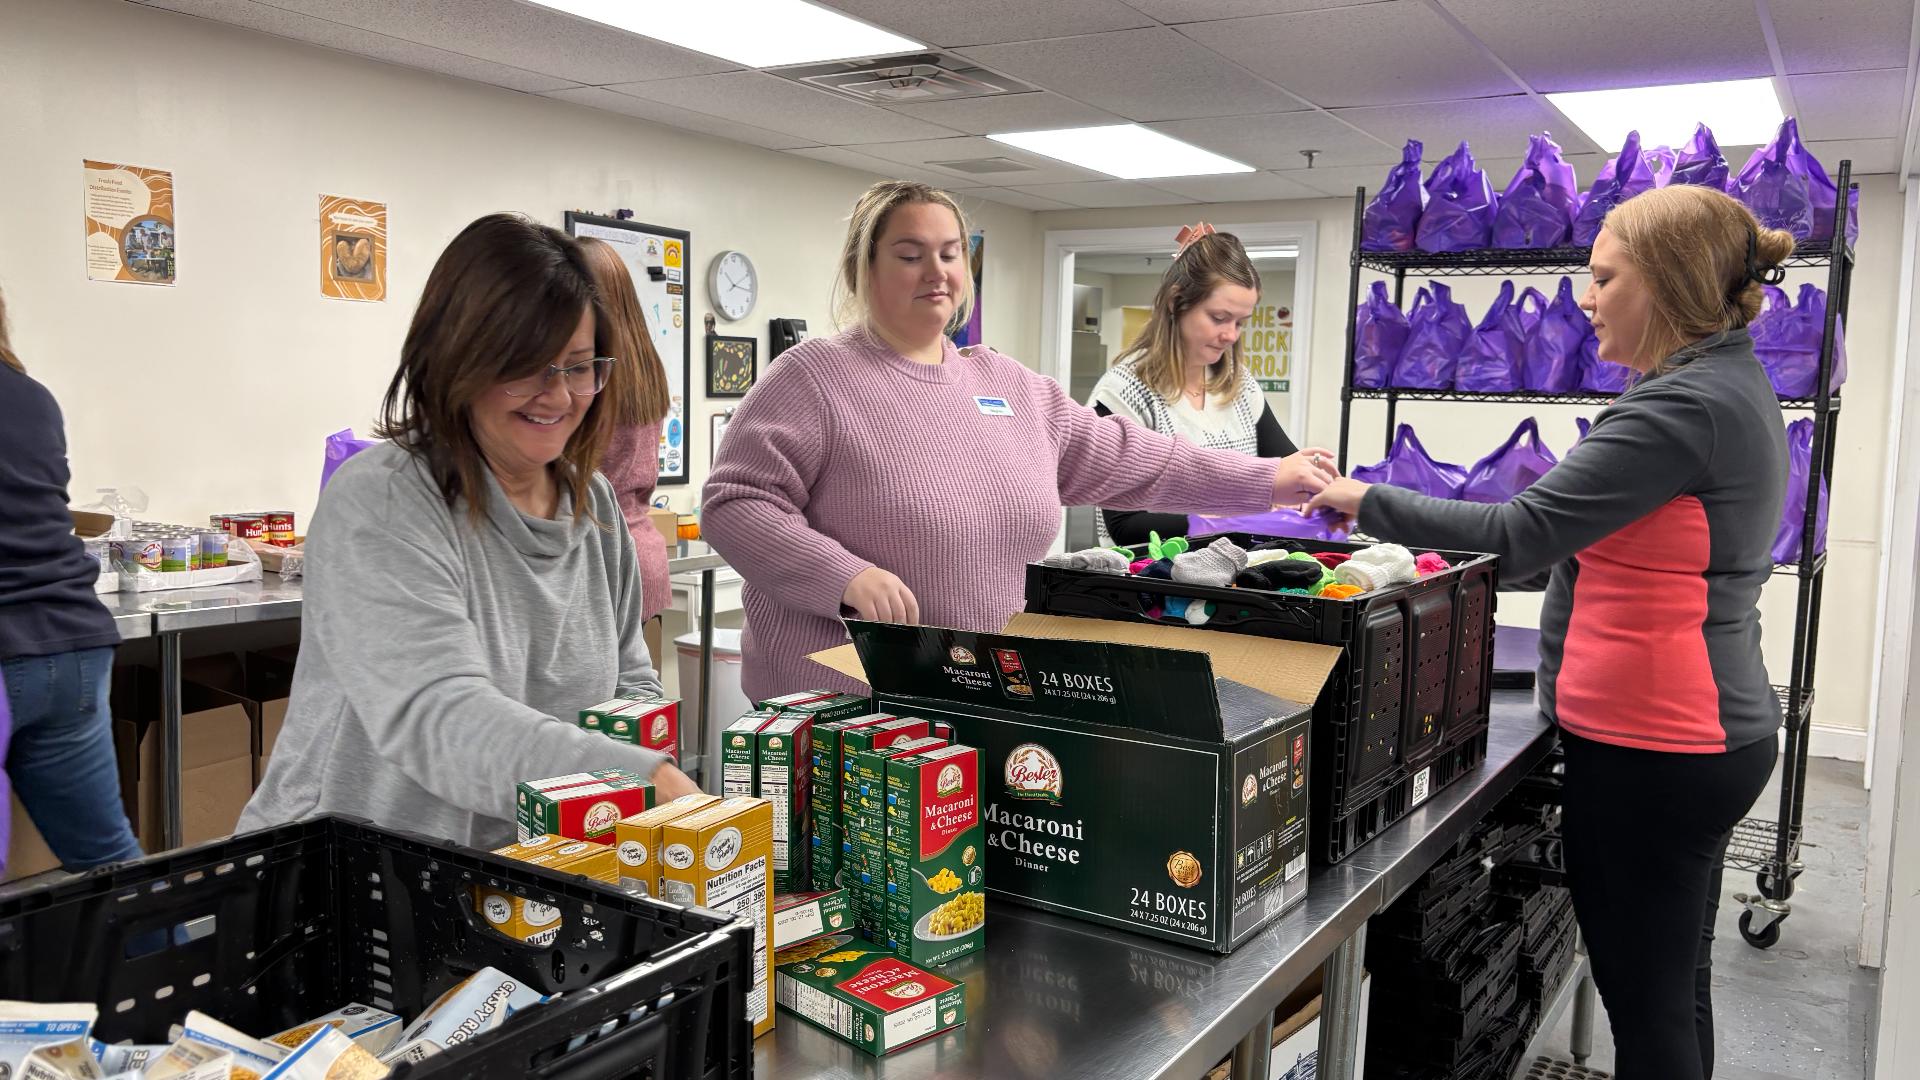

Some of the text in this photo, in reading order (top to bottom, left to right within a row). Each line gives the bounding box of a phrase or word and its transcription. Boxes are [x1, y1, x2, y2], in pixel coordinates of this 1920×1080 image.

[1243, 305, 1276, 328] HE
[1241, 330, 1293, 352] LOCK
[1243, 354, 1288, 377] PROJ
[942, 666, 991, 680] Macaroni
[1038, 671, 1113, 692] 24 BOXES
[1259, 756, 1288, 780] Macaroni
[925, 794, 974, 818] Macaroni
[984, 803, 1084, 841] Macaroni
[707, 869, 743, 890] Nutrition
[745, 858, 765, 873] Facts
[1014, 857, 1049, 872] Dinner
[737, 890, 766, 910] 250 390
[1130, 888, 1207, 920] 24 BOXES
[1130, 909, 1139, 917] 24
[1145, 912, 1159, 923] 7.25
[1159, 915, 1169, 925] OZ
[1169, 918, 1181, 928] (24
[1186, 921, 1199, 932] 206
[526, 927, 561, 946] Nutrit
[856, 970, 921, 995] Macaroni
[446, 980, 516, 1046] CRISPY RICE
[45, 1023, 56, 1032] TO
